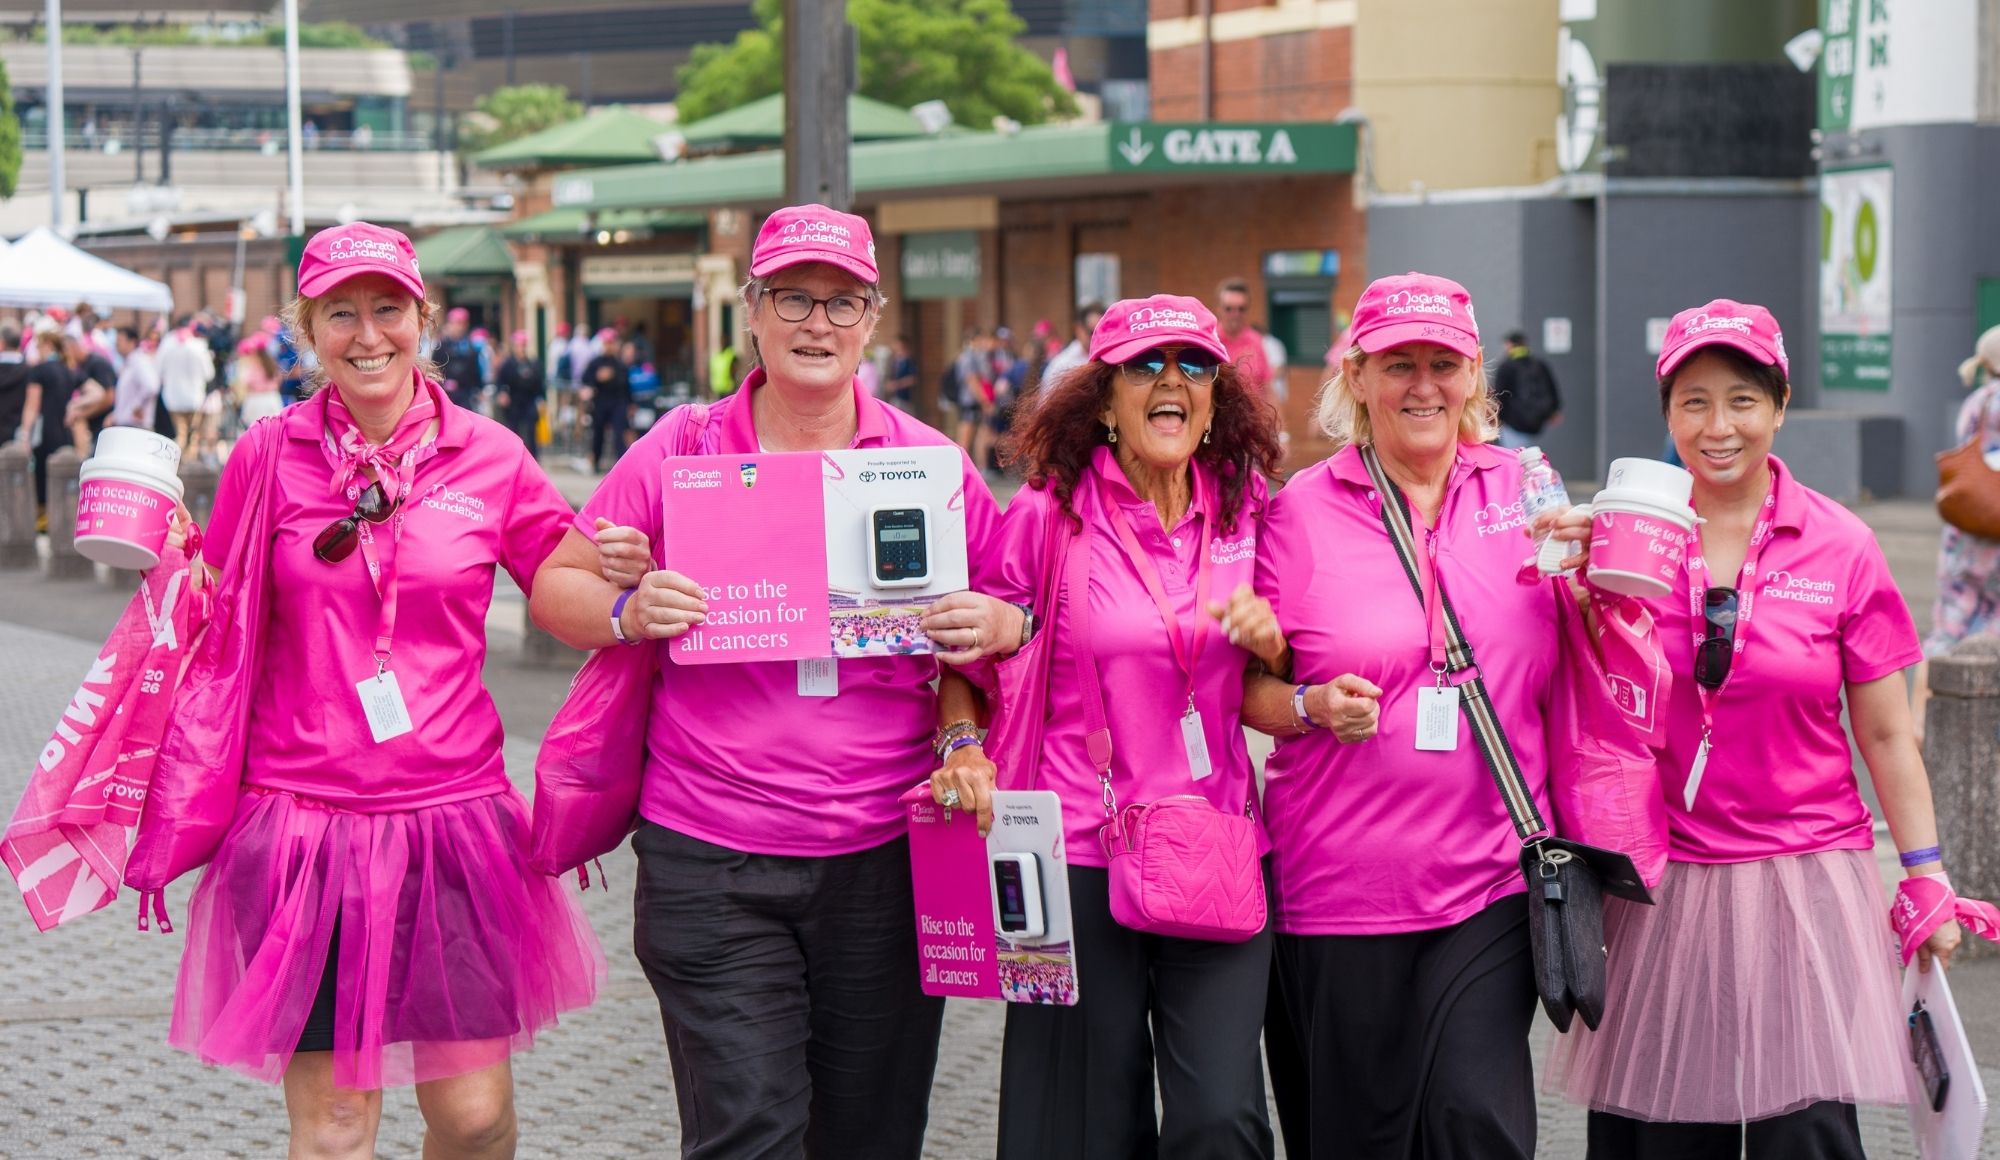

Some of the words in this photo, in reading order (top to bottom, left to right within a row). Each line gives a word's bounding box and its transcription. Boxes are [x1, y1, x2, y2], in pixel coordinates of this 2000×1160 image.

[1163, 129, 1262, 164] GATE
[1266, 129, 1297, 164] A
[784, 219, 851, 239] McGrath
[329, 237, 397, 254] McGrath
[781, 231, 851, 249] Foundation
[330, 248, 398, 264] Foundation
[1385, 290, 1450, 308] McGrath
[1128, 307, 1197, 323] McGrath
[1386, 303, 1453, 318] Foundation
[1130, 318, 1200, 334] Foundation
[1684, 319, 1751, 337] Foundation
[673, 469, 721, 482] McGrath
[673, 479, 722, 489] Foundation
[880, 470, 927, 480] TOYOTA
[84, 483, 101, 498] the
[102, 486, 158, 511] occasion
[425, 483, 485, 511] McGrath
[90, 501, 138, 519] cancers
[421, 496, 484, 522] Foundation
[1633, 518, 1663, 538] Rise
[1648, 538, 1668, 556] for
[701, 585, 722, 601] se
[727, 584, 749, 600] to
[754, 578, 788, 599] the
[1765, 570, 1835, 593] McGrath
[1763, 585, 1834, 605] Foundation
[697, 605, 771, 626] casion
[777, 602, 807, 623] for
[681, 631, 703, 652] all
[709, 632, 789, 651] cancers
[145, 669, 164, 682] 20
[141, 683, 160, 694] 26
[39, 652, 118, 773] PINK
[912, 814, 936, 825] Foundation
[1013, 815, 1040, 826] TOYOTA
[921, 914, 943, 935] Rise
[944, 918, 957, 935] to
[957, 916, 975, 937] the
[924, 940, 968, 961] occasion
[970, 941, 986, 962] for
[926, 962, 937, 983] all
[939, 969, 979, 986] cancers
